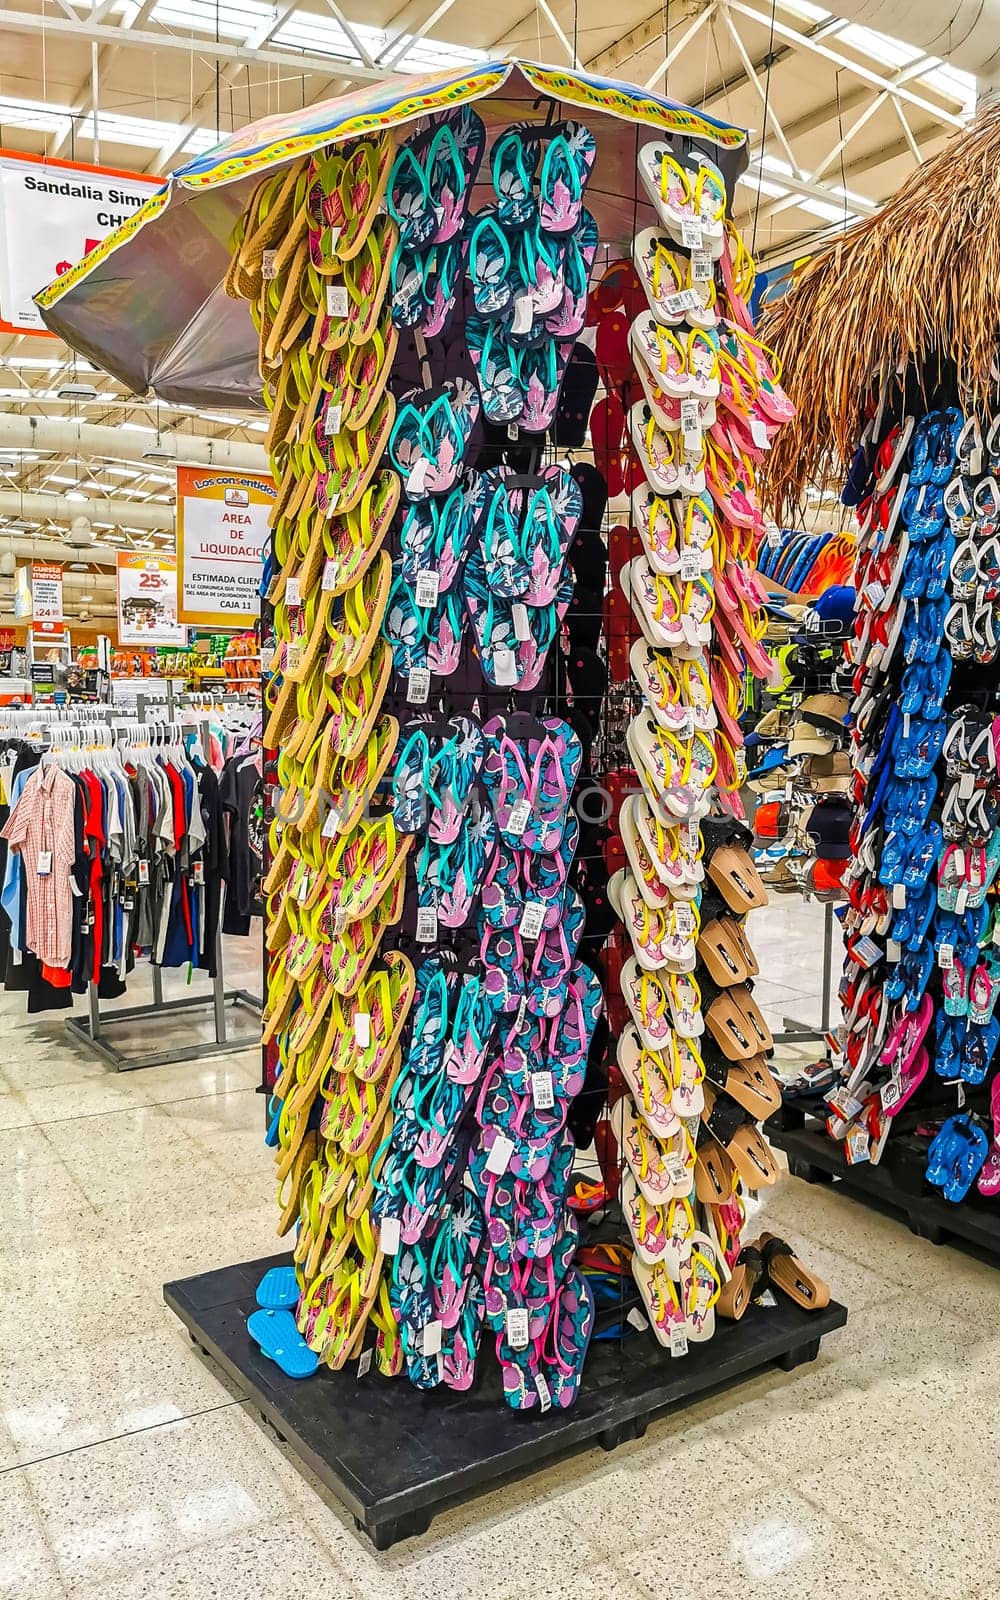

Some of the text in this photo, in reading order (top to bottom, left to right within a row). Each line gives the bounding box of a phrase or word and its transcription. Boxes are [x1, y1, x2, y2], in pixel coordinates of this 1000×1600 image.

[24, 176, 103, 202] Sandalia
[194, 476, 278, 498] Los consentidos
[222, 513, 252, 525] AREA
[230, 530, 244, 540] DE
[192, 573, 236, 584] ESTIMADA
[220, 601, 241, 609] CAJA
